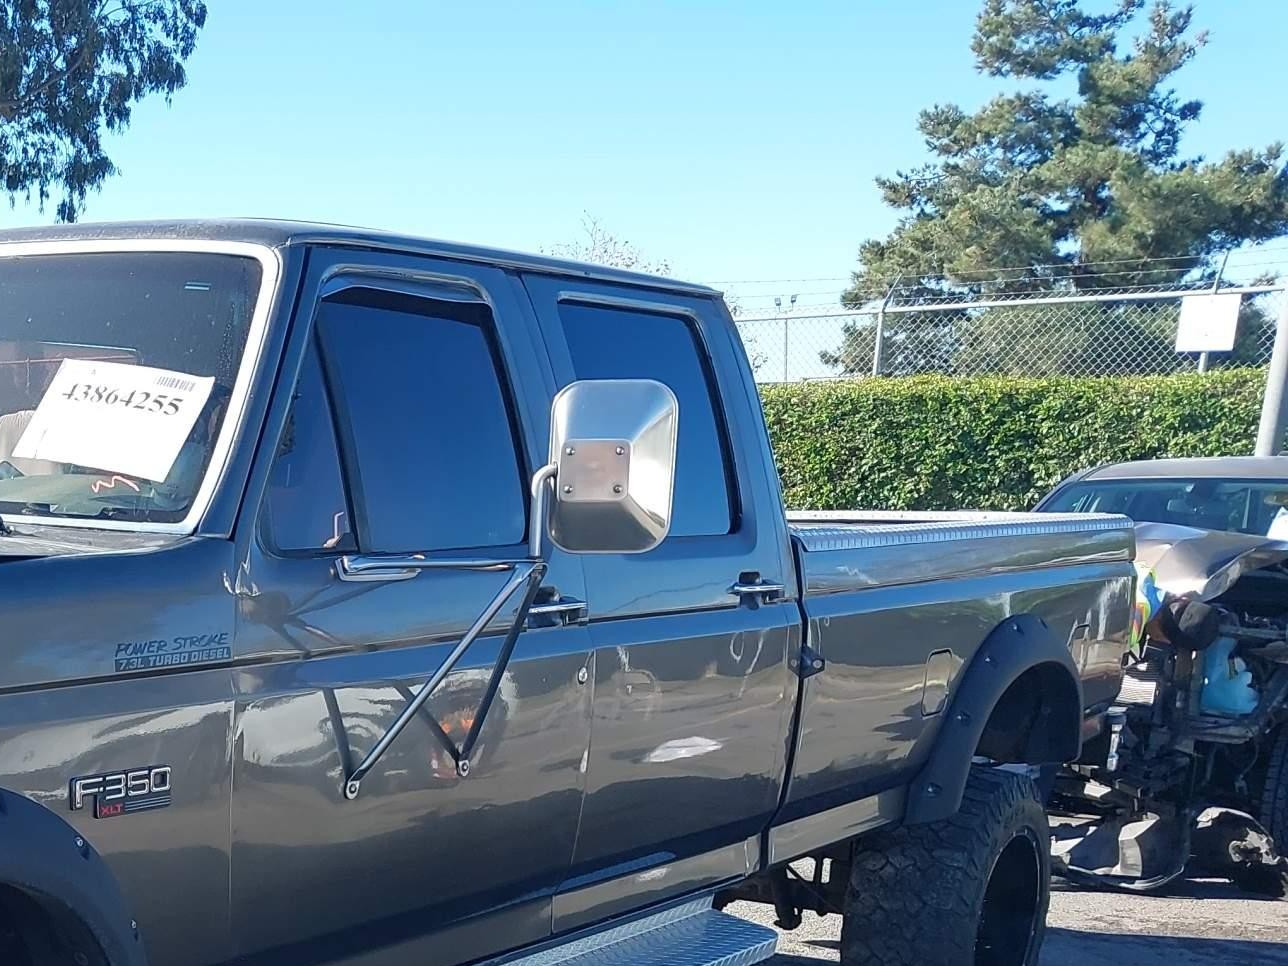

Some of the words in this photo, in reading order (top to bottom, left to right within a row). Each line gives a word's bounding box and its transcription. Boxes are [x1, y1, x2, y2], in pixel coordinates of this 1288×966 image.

[62, 383, 185, 416] 43864255
[115, 639, 168, 658] POWER
[172, 632, 229, 652] STROKE
[119, 657, 145, 671] 7.3L
[149, 651, 189, 667] TURBO
[191, 646, 230, 662] DIESEL
[100, 802, 123, 815] XLT
